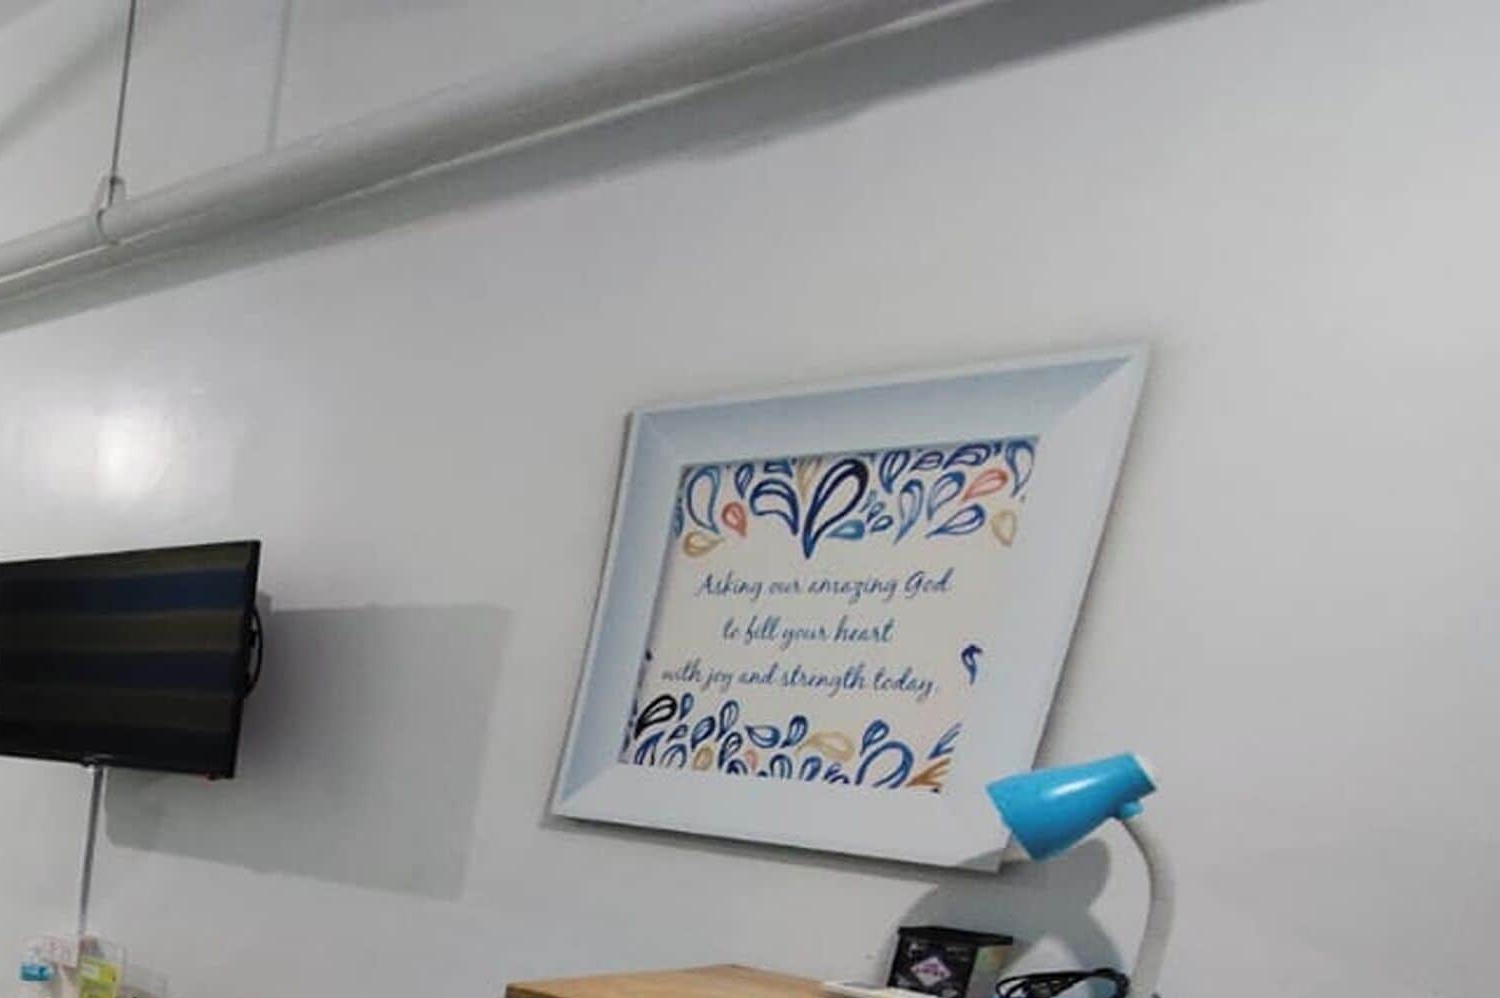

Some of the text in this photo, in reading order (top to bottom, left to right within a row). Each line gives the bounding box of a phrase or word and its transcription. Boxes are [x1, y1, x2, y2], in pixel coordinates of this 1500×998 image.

[693, 566, 955, 604] Asking our amazing God
[722, 614, 895, 652] to fill your heart
[662, 657, 702, 682] with
[701, 668, 734, 693] joy
[738, 660, 778, 684] and
[781, 660, 866, 698] strength
